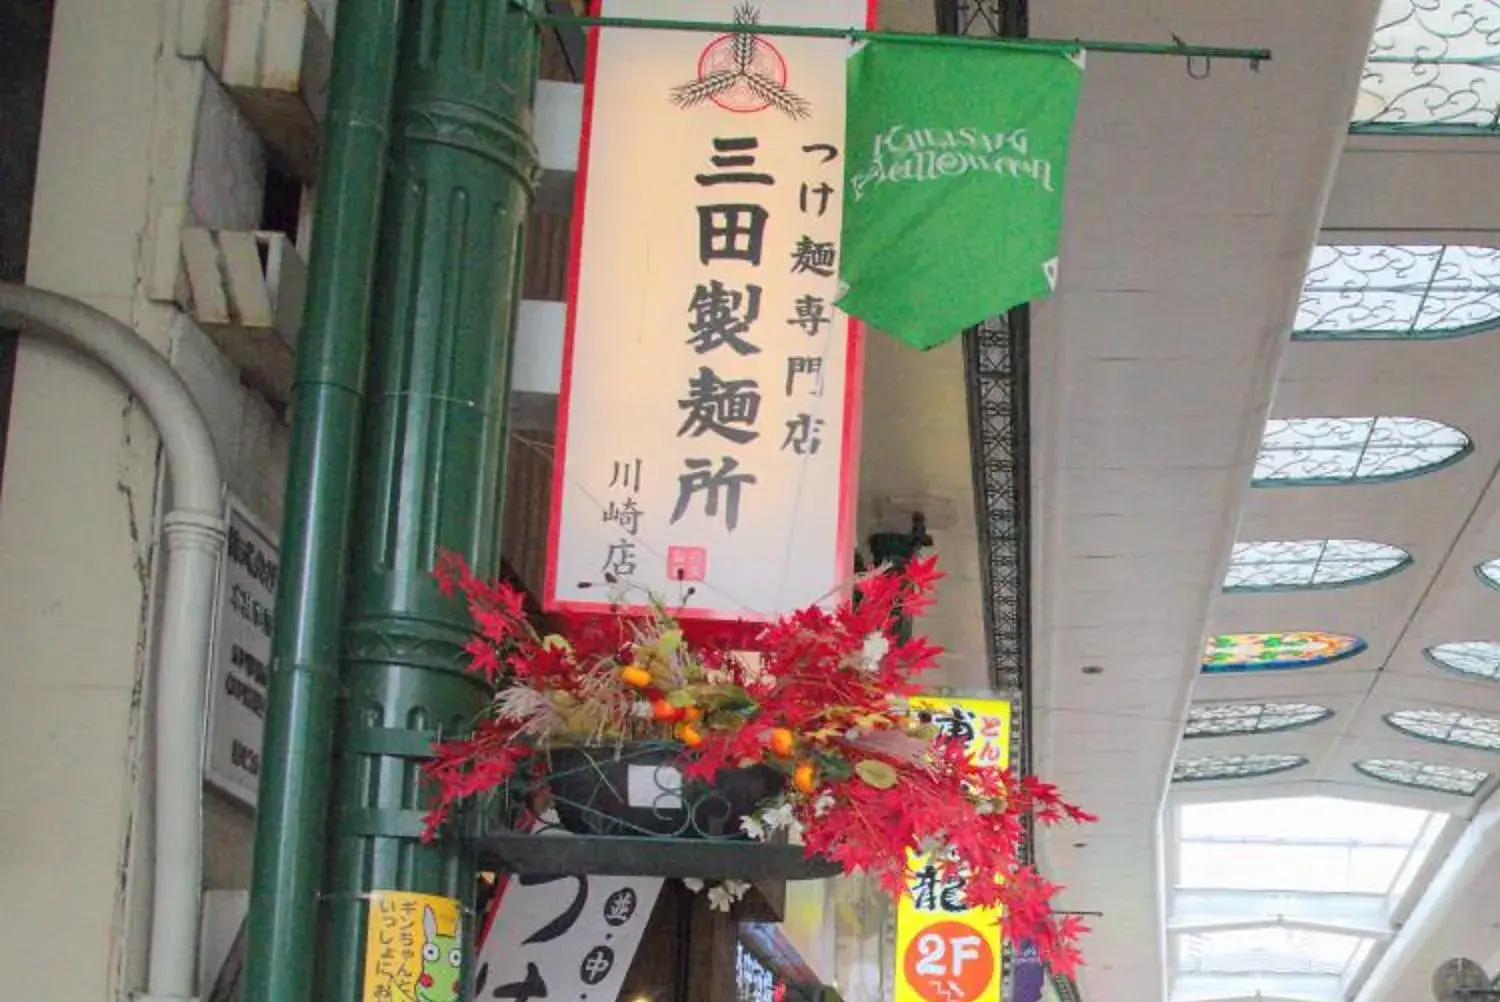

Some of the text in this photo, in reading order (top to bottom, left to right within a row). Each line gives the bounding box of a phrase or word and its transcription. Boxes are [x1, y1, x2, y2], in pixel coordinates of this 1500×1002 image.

[670, 136, 776, 533] 三田製麺所
[779, 142, 840, 457] つけ麺専門店
[601, 458, 646, 580] 川崎店
[916, 932, 982, 977] 2F
